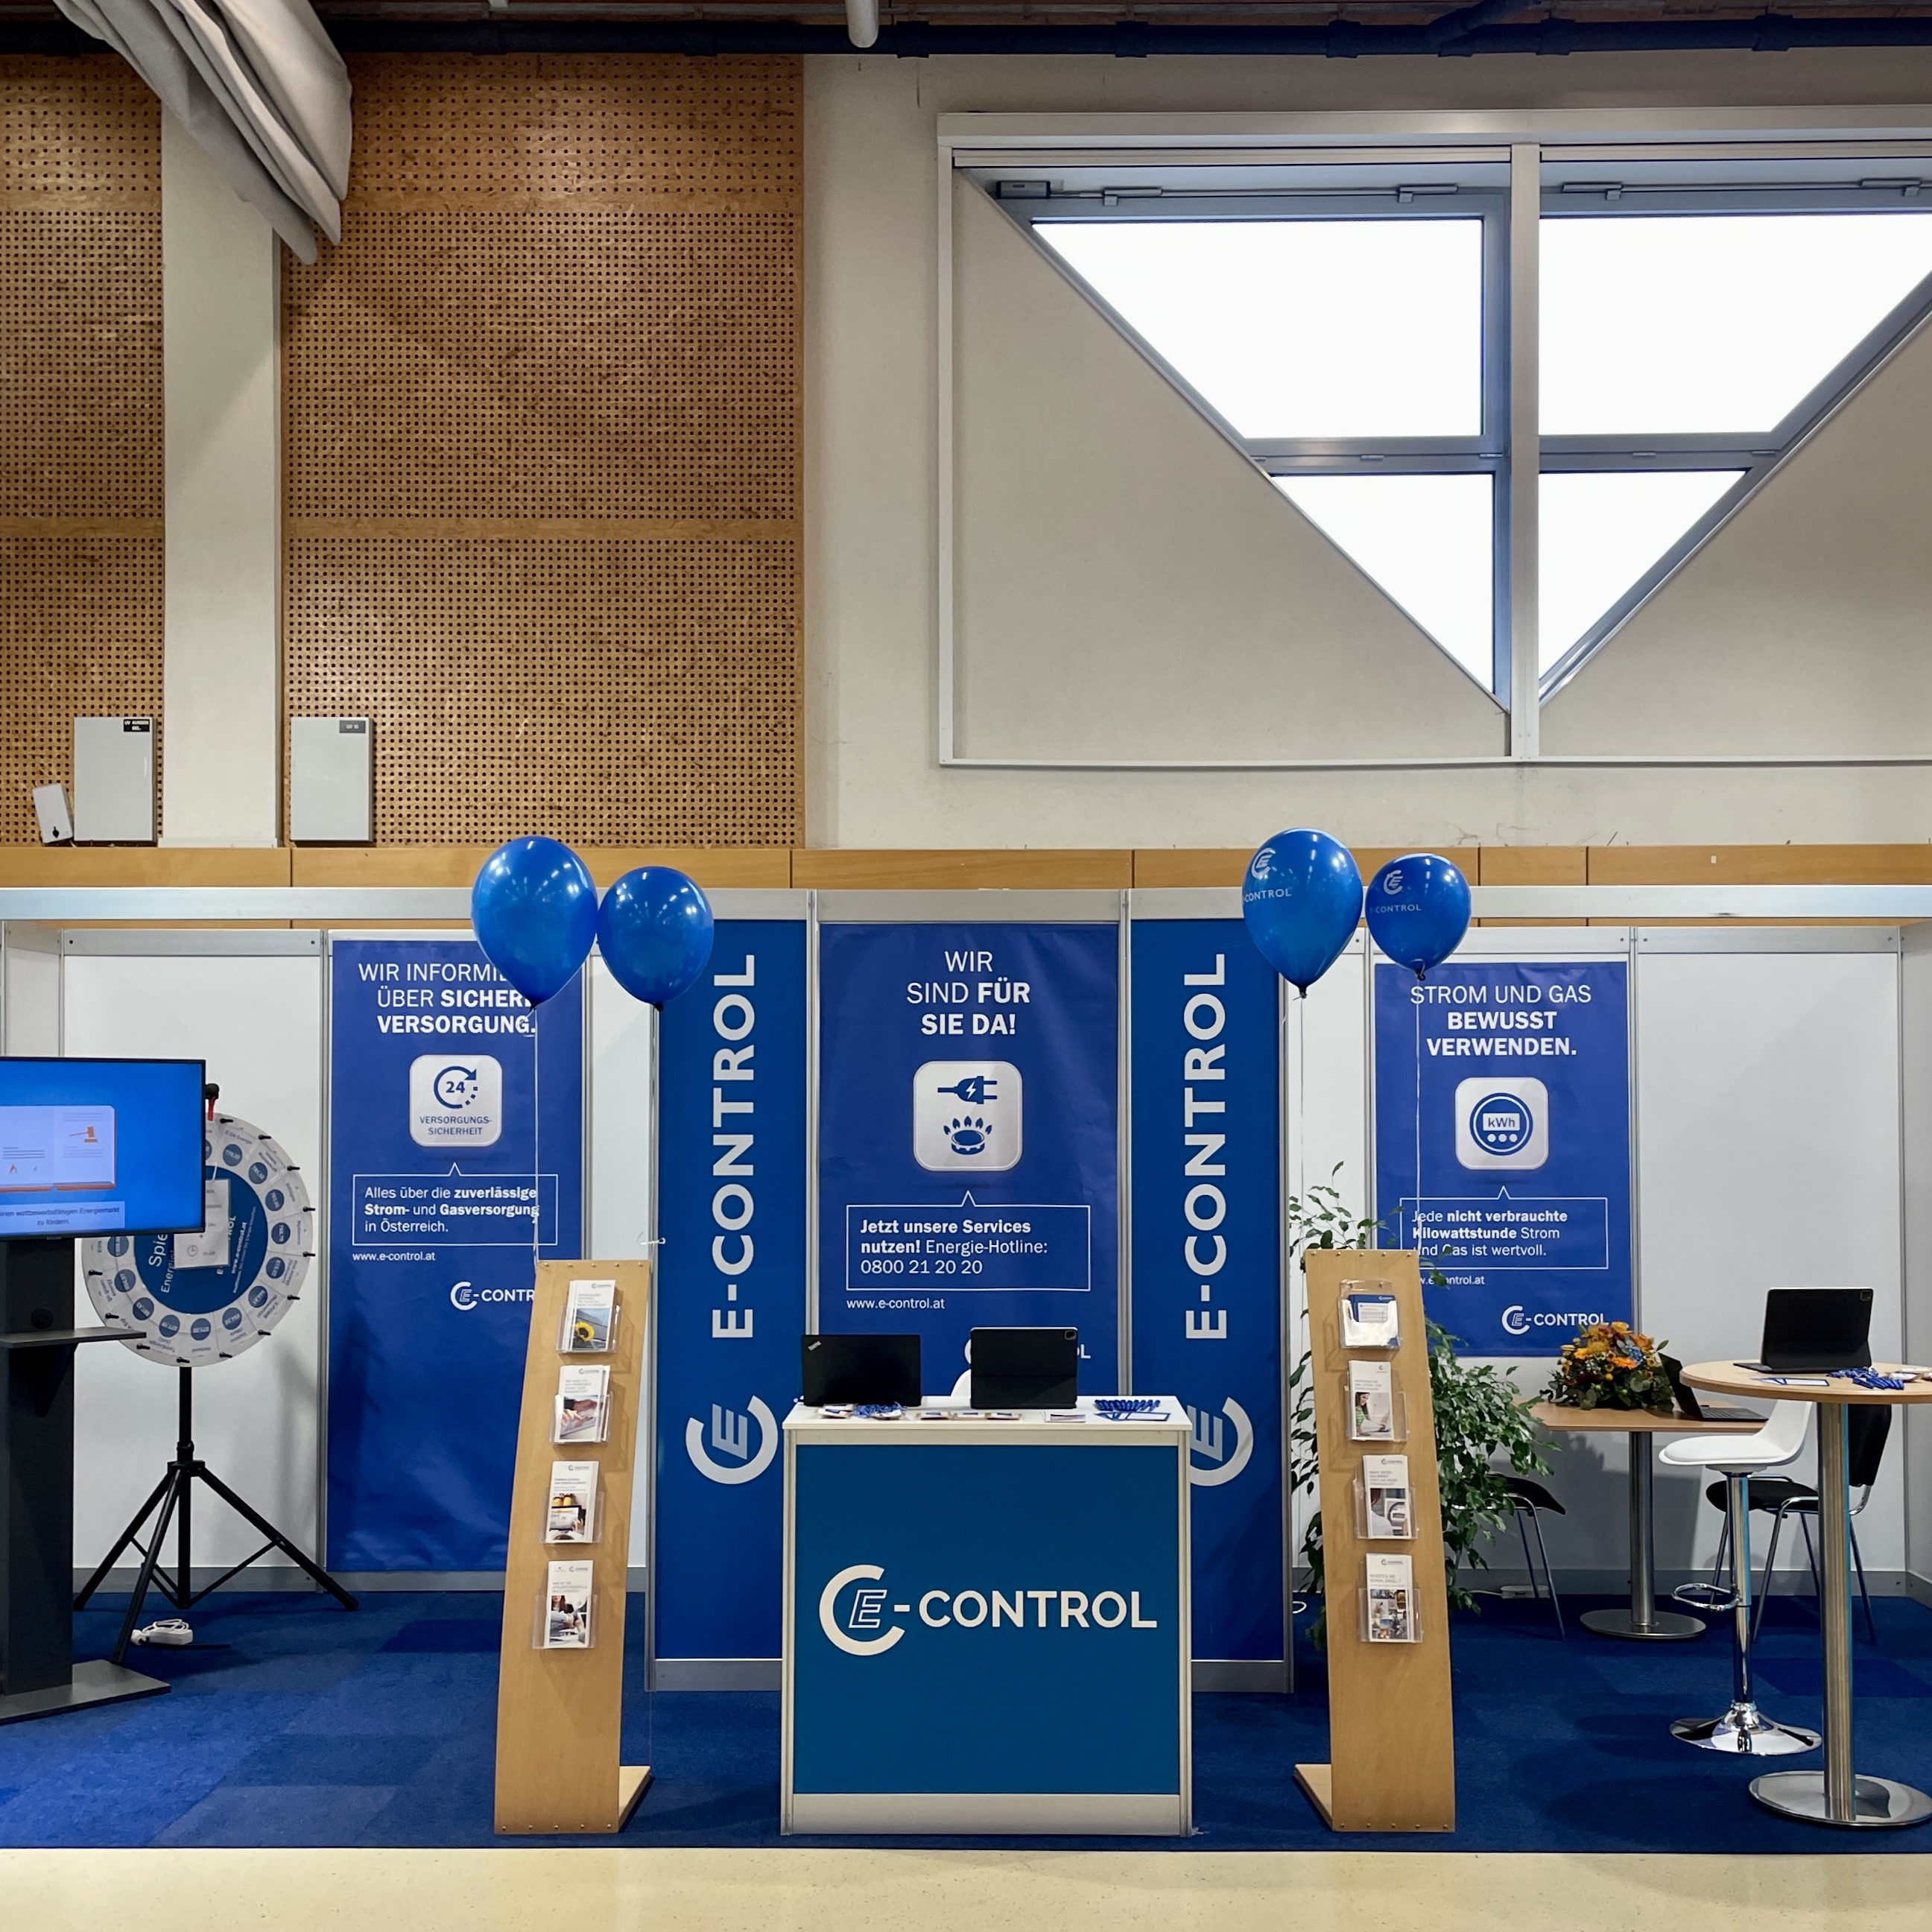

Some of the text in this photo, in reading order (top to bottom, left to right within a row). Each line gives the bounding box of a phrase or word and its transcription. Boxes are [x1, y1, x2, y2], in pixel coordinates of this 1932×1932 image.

[1242, 888, 1292, 904] -CONTROL
[944, 951, 992, 972] WIR
[358, 963, 507, 981] WIR INFORMI
[378, 985, 532, 1008] ÜBER SICHER
[907, 977, 1030, 1004] SIND FÜR
[1410, 984, 1591, 1004] STROM UND GAS
[377, 1013, 536, 1033] VERSORGUNG.
[921, 1013, 1016, 1035] SIE DA!
[1448, 1011, 1557, 1030] BEWUSST
[1426, 1037, 1577, 1056] VERWENDEN.
[446, 1081, 466, 1094] 24
[419, 1115, 491, 1124] VERSORGUNGS-
[1488, 1117, 1515, 1128] kWh
[428, 1127, 483, 1136] SICHERHEIT
[712, 954, 755, 1338] E-CONTROL
[1183, 954, 1227, 1339] E-CONTROL
[365, 1186, 537, 1200] Alles über die zuverlässige
[364, 1203, 539, 1218] Strom- und Gasversorgung
[1412, 1210, 1568, 1222] Jede nicht verbrauchte
[365, 1217, 449, 1232] in Österreich.
[860, 1219, 1031, 1233] Jetzt unsere Services
[1413, 1226, 1559, 1239] Kilowattstunde Strom
[148, 1234, 168, 1267] Spie
[861, 1239, 1048, 1257] nutzen! Energie-Hotline:
[1413, 1244, 1437, 1256] nd
[1472, 1245, 1488, 1256] ist
[1491, 1244, 1546, 1256] wertvoll.
[352, 1252, 435, 1261] www.e-control.at
[861, 1259, 983, 1274] 0800 21 20 20
[846, 1298, 945, 1309] www.e-control.at
